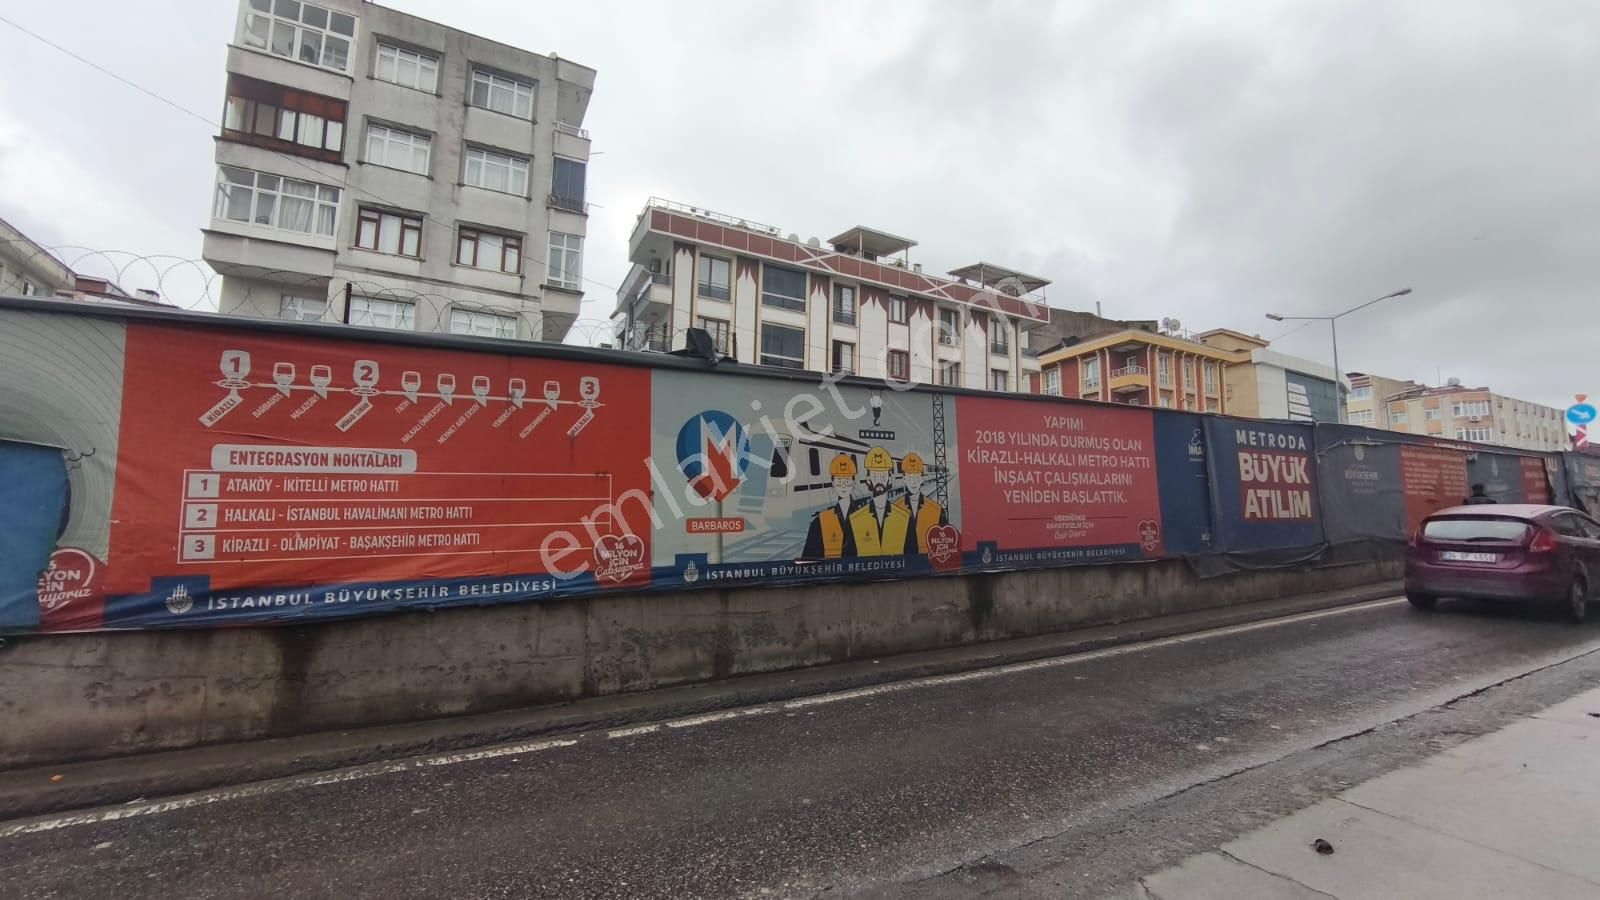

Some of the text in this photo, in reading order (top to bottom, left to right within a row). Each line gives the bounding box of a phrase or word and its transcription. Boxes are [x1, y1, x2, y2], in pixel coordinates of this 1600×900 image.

[229, 356, 241, 373] 1
[359, 365, 373, 381] 2
[584, 381, 595, 395] 3
[206, 398, 237, 423] KİRAZLI
[1043, 415, 1084, 431] YAPIMI
[975, 430, 1142, 452] 2018 YILINDA DURMUŞ OLAN
[1235, 429, 1306, 450] METRODA
[229, 450, 402, 468] ENTEGRASYON NOKTALARI
[967, 447, 1150, 469] KİRAZLI-HALKALI METRO HATTI
[1238, 452, 1310, 484] BÜYÜK
[200, 477, 209, 492] 1
[226, 477, 273, 493] ATAKÖY
[283, 476, 329, 493] İKİTELLİ
[331, 479, 367, 493] METRO
[370, 479, 399, 493] HATTI
[994, 466, 1133, 488] İNŞAAT ÇALIŞMALARINI
[1003, 486, 1128, 506] YENİDEN BAŞLATTIK.
[1244, 489, 1312, 518] ATILIM
[196, 508, 208, 522] 2
[224, 507, 276, 522] HALKALI
[286, 505, 341, 521] İSTANBUL
[344, 505, 408, 520] HAVALİMANI
[410, 507, 445, 520] METRO
[446, 506, 472, 519] HATTI
[691, 520, 741, 531] BARBAROS
[193, 539, 205, 553] 3
[222, 536, 270, 553] KİRAZLI
[280, 534, 340, 551] OLİMPİYAT
[350, 532, 416, 550] BAŞAKŞEHİR
[418, 533, 451, 547] METRO
[453, 533, 480, 546] HATTI
[614, 542, 624, 550] 16
[996, 547, 1126, 561] İSTANBUL BÜYÜKŞEHİR BELEDİYESİ
[706, 559, 906, 580] İSTANBUL BÜYÜKŞEHİR BELEDİYESİ
[207, 580, 557, 611] İSTANBUL BÜYÜKŞEHİR BELEDİYESİ
